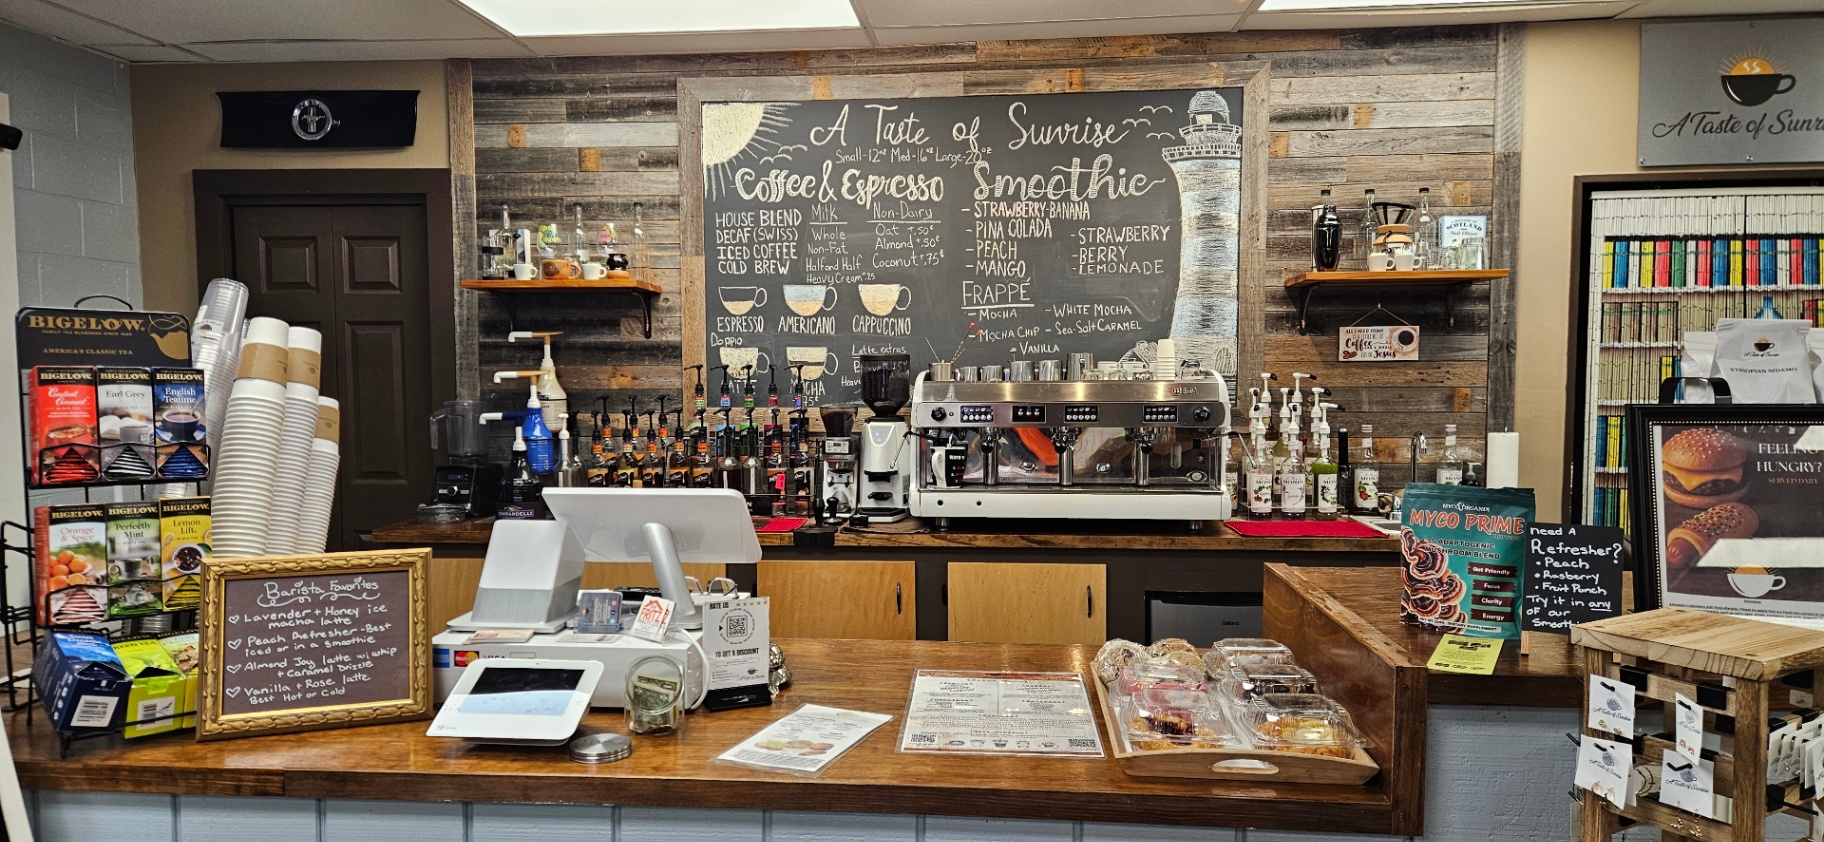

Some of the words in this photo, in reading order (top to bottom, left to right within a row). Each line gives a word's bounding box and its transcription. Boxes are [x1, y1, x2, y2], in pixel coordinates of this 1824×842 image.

[810, 104, 850, 145] A
[864, 105, 930, 145] Taste
[953, 116, 979, 152] of
[1008, 102, 1129, 150] Sunrise
[1652, 112, 1691, 138] A
[1690, 111, 1742, 136] Taste
[1746, 113, 1767, 140] of
[1768, 109, 1824, 135] Sunr
[974, 153, 1165, 202] Smoothie
[731, 167, 816, 203] Coffee
[818, 160, 837, 203] &
[841, 169, 944, 210] Espresso
[811, 203, 838, 221] Milk
[873, 201, 932, 220] Non-Dairy
[715, 211, 755, 228] HOUSE
[760, 209, 801, 227] BLEND
[812, 227, 846, 241] Whole
[876, 223, 899, 236] Oat
[976, 221, 1004, 239] PINA
[1008, 218, 1052, 238] COLADA
[1446, 223, 1482, 231] SCOTLAND
[716, 228, 751, 243] DECAF
[753, 228, 798, 243] (SWISS)
[1079, 225, 1170, 244] STRAWBERRY
[807, 243, 848, 256] Non-Fat
[875, 236, 913, 250] Almond
[976, 240, 1017, 260] PEACH
[717, 244, 750, 260] ICED
[753, 243, 797, 260] COFFEE
[1079, 246, 1128, 263] BERRY
[718, 261, 747, 275] COLD
[755, 260, 790, 275] BREW
[806, 257, 826, 272] Half
[842, 255, 862, 271] Half
[873, 253, 918, 269] Coconut
[1079, 260, 1164, 275] LEMONADE
[976, 260, 1026, 277] MANGO
[807, 273, 835, 286] Heavy
[835, 273, 862, 284] Cream
[963, 277, 1031, 306] FRAPPÉ
[979, 308, 1018, 320] MOCHA
[1053, 304, 1089, 316] WHITE
[1094, 303, 1132, 317] MOCHA
[28, 315, 144, 331] BIGELOW
[717, 316, 764, 332] ESPRESSO
[778, 316, 836, 334] AMERICANO
[853, 315, 911, 336] CAPPUCCINO
[1097, 319, 1142, 332] CARAMEL
[711, 332, 743, 347] Doppio
[981, 329, 1016, 342] MOCHA
[1018, 326, 1040, 338] CHIP
[852, 345, 878, 355] Latte
[881, 343, 906, 353] extras
[1019, 342, 1060, 354] VANILLA
[1345, 338, 1372, 351] Coffee
[1374, 350, 1396, 358] Jesus
[48, 387, 78, 397] Constant
[106, 390, 123, 398] Earl
[125, 391, 146, 399] Grey
[165, 388, 196, 397] English
[55, 397, 87, 406] Comment
[1757, 461, 1822, 472] HUNGRY?
[51, 510, 103, 519] BIGELOW
[108, 506, 158, 516] BIGELOW
[116, 522, 152, 531] Perfectly
[1410, 509, 1459, 529] MYCO
[1465, 514, 1525, 535] PRIME
[71, 534, 94, 542] Spice
[1530, 527, 1563, 536] need
[1568, 527, 1576, 536] A
[1438, 540, 1494, 549] ADAPTOGENIC
[1531, 538, 1622, 564] Refresher?
[1424, 546, 1472, 556] MUSHROOM
[1474, 552, 1500, 560] BLEND
[1545, 557, 1589, 570] Peach
[1472, 566, 1483, 574] Gut
[1484, 568, 1510, 576] Friendly
[1543, 571, 1599, 584] Rasberry
[264, 581, 325, 599] Barista
[330, 576, 378, 592] Favorites
[1483, 582, 1500, 590] Focus
[1543, 582, 1569, 593] Fruit
[1572, 584, 1607, 596] Punch
[1481, 597, 1503, 606] Clarity
[1526, 595, 1548, 607] Try
[1553, 595, 1566, 604] it
[1571, 598, 1584, 606] in
[1589, 600, 1611, 611] any
[244, 609, 311, 623] Lavender
[325, 607, 359, 618] Honey
[368, 604, 388, 614] ice
[641, 608, 662, 625] FRITZ
[1482, 613, 1504, 621] Energy
[1548, 609, 1571, 617] our
[321, 617, 351, 626] latte
[248, 635, 286, 648] Peach
[292, 627, 357, 640] Refresher
[277, 646, 289, 654] or
[737, 648, 759, 656] DISCOUNT
[244, 659, 287, 671] Almond
[294, 658, 315, 669] Joy
[323, 655, 351, 665] latte
[371, 647, 397, 659] whip
[278, 670, 284, 678] +
[287, 665, 333, 677] Caramel
[339, 660, 373, 672] Drizzle
[244, 684, 291, 696] Vanilla
[306, 677, 336, 689] Rose
[343, 673, 371, 684] latte
[249, 696, 275, 705] Best
[284, 692, 303, 702] Hot
[322, 687, 346, 697] Cold
